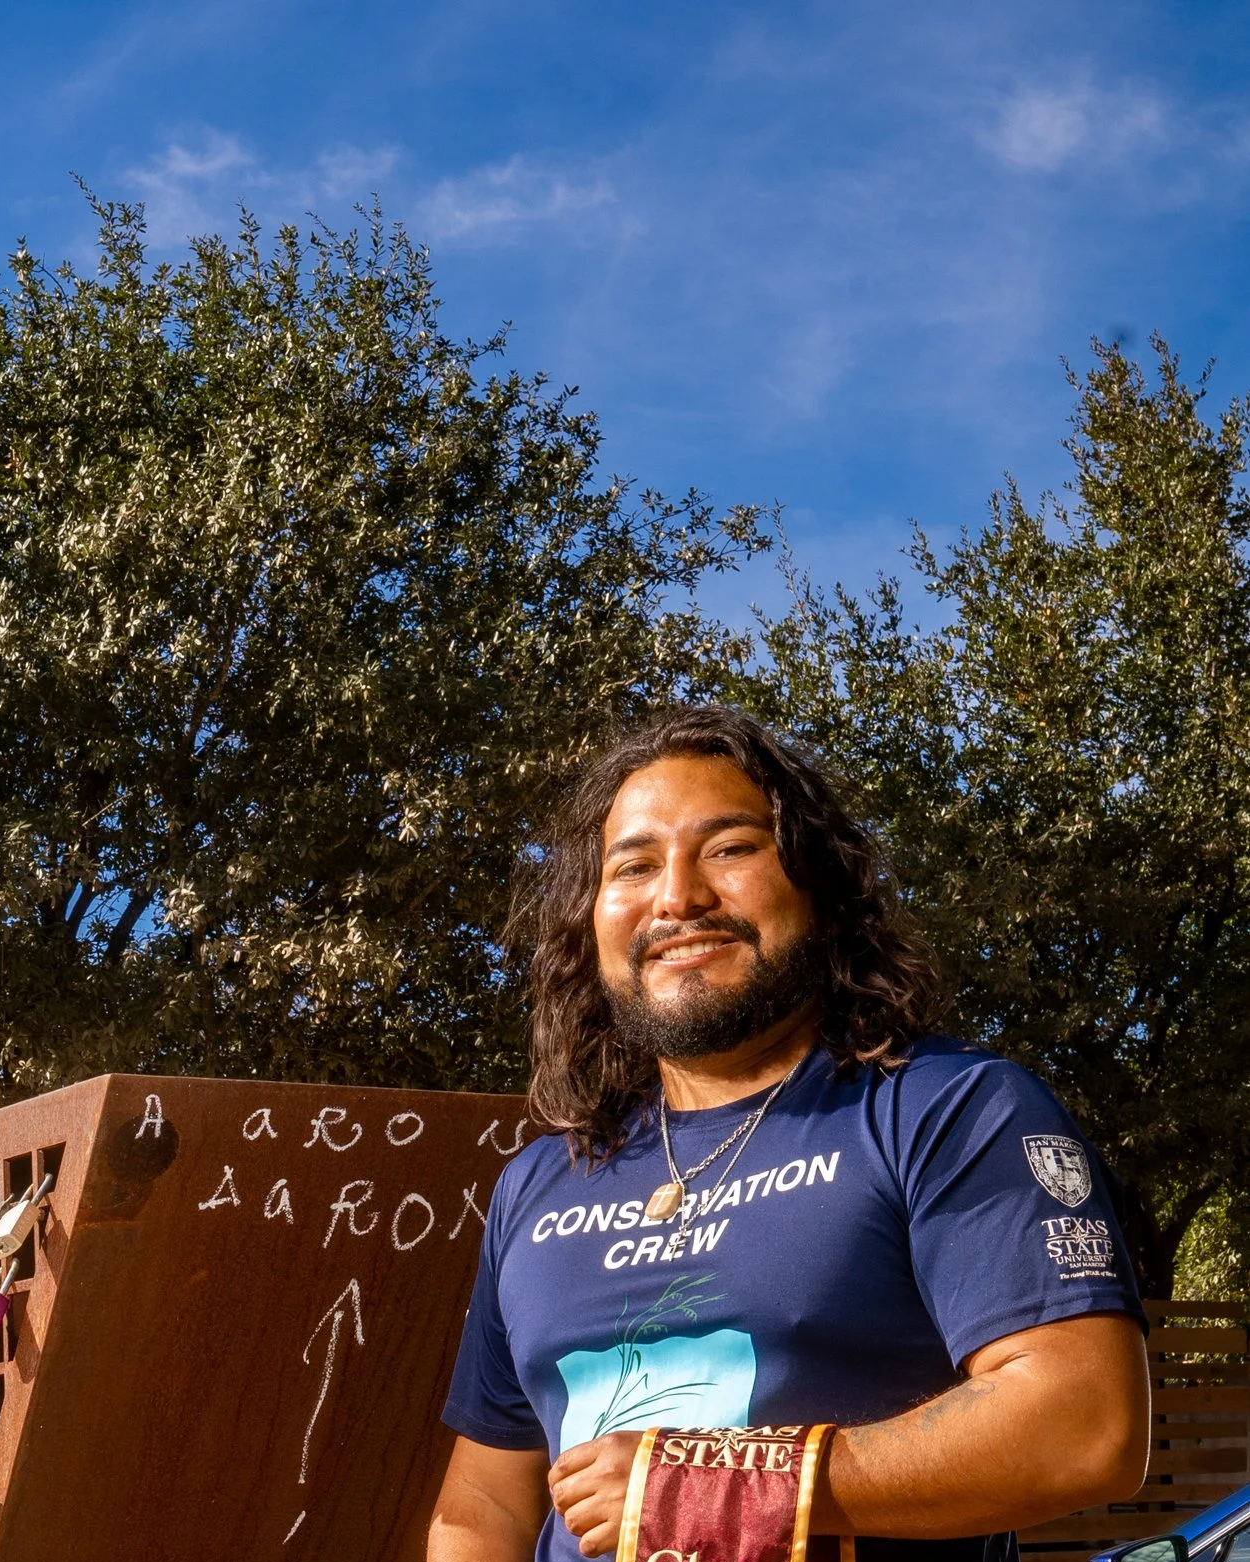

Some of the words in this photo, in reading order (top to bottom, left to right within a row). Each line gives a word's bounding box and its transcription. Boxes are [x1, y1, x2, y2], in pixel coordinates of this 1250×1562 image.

[1029, 1139, 1049, 1148] SAN
[1041, 1216, 1109, 1237] TEXAS
[603, 1219, 730, 1270] CREW
[1046, 1238, 1115, 1258] STATE
[1056, 1254, 1113, 1265] UNIVERSITY
[660, 1438, 793, 1472] STATE
